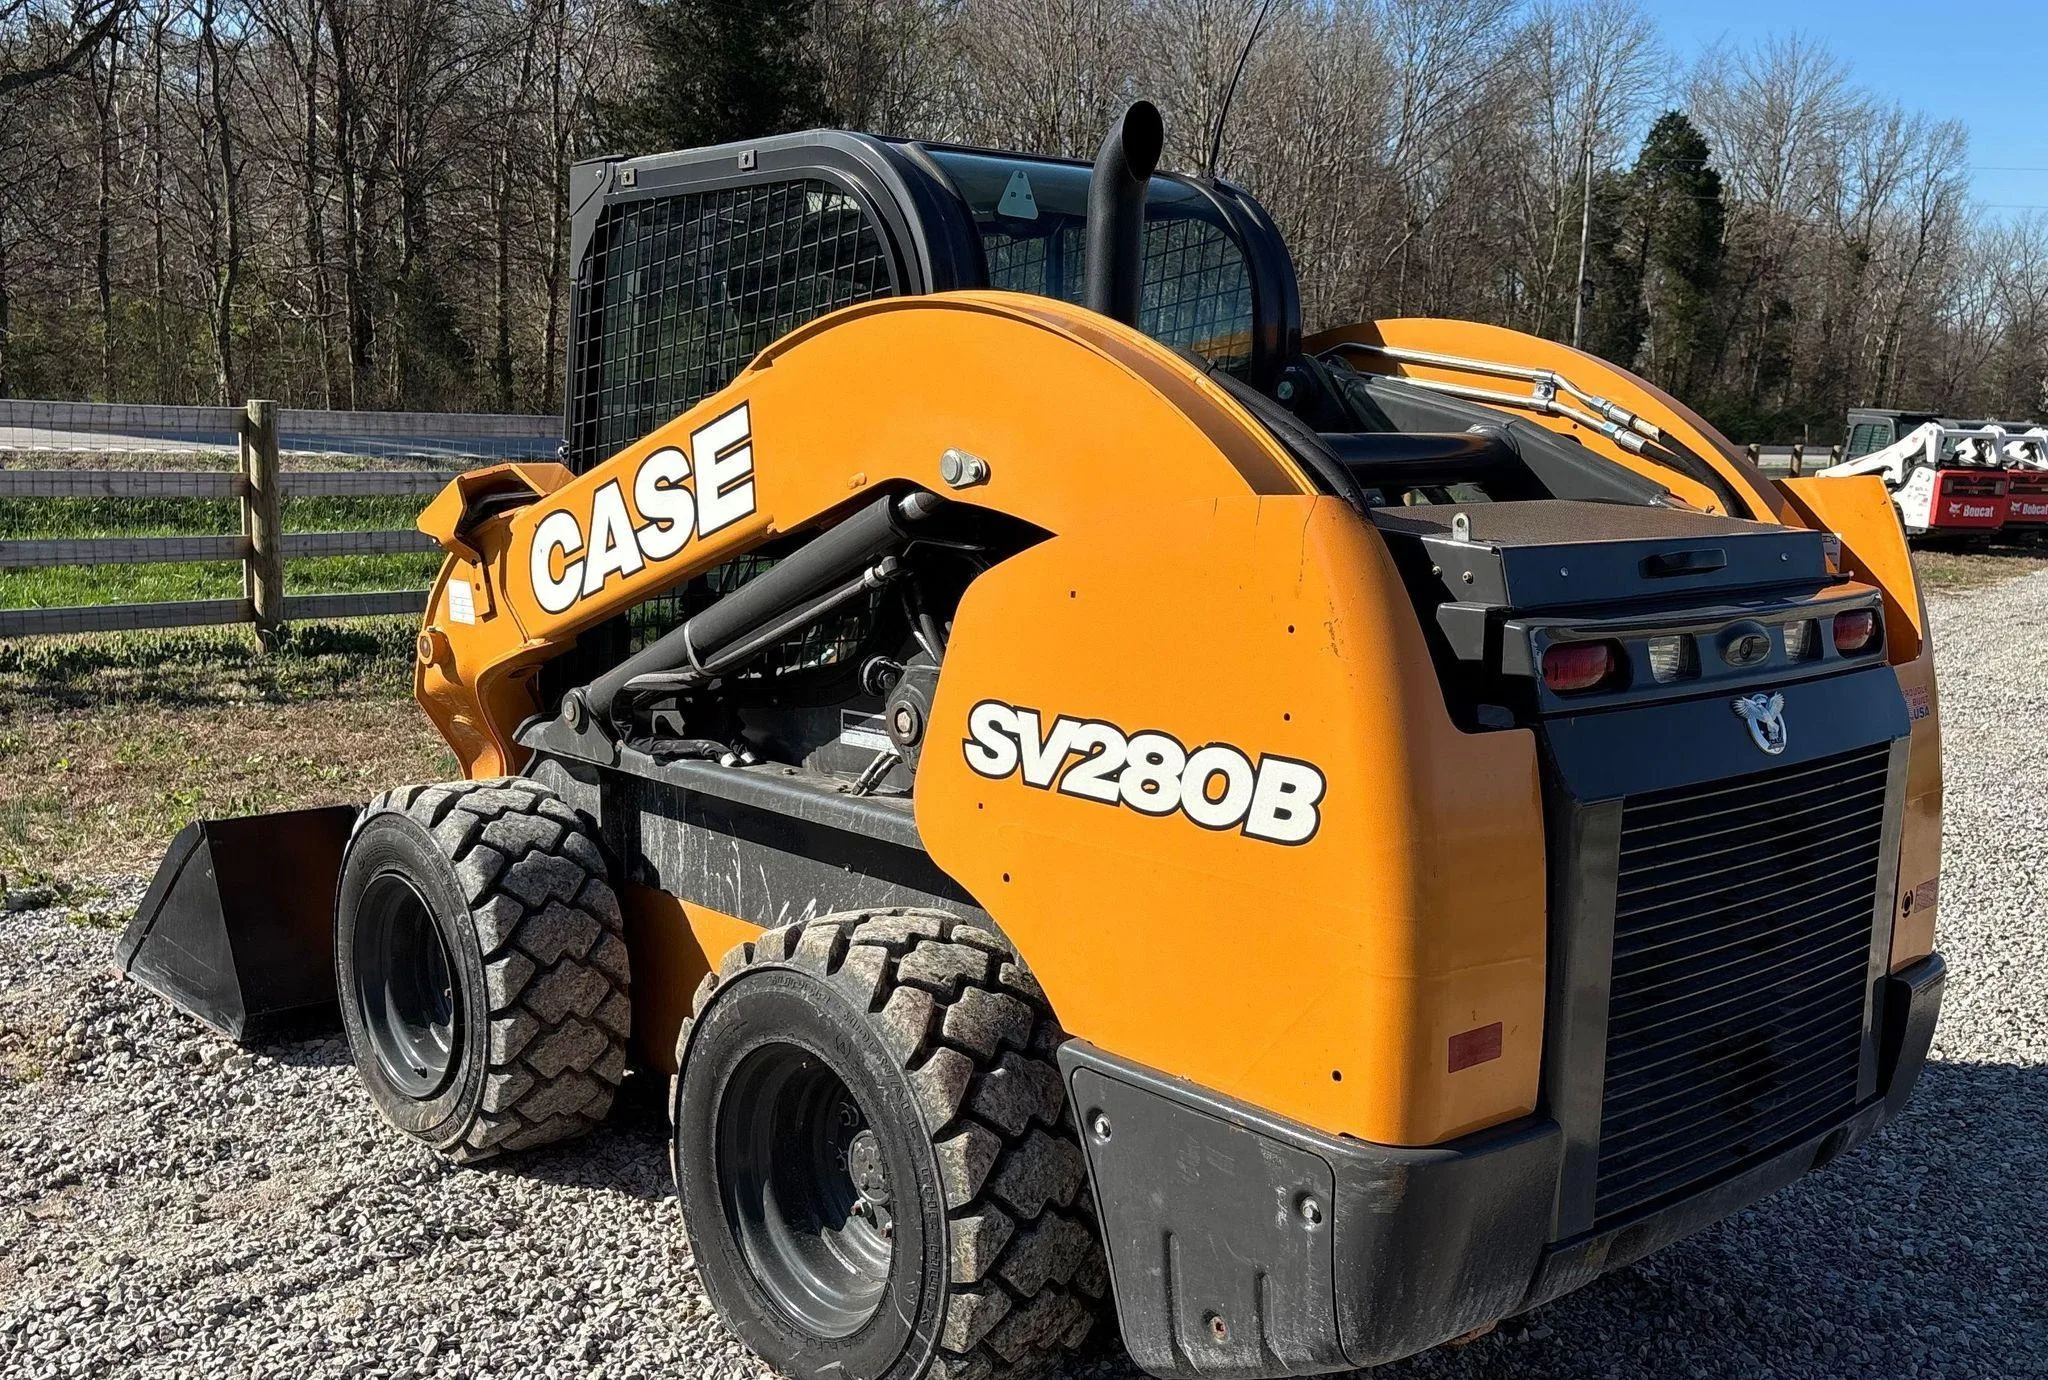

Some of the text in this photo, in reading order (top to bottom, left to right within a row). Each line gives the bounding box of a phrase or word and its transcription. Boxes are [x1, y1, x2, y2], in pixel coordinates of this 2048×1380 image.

[529, 399, 757, 614] CASE
[1963, 504, 1994, 518] Bobcat
[1913, 706, 1930, 720] USA
[962, 699, 1327, 846] SV280B
